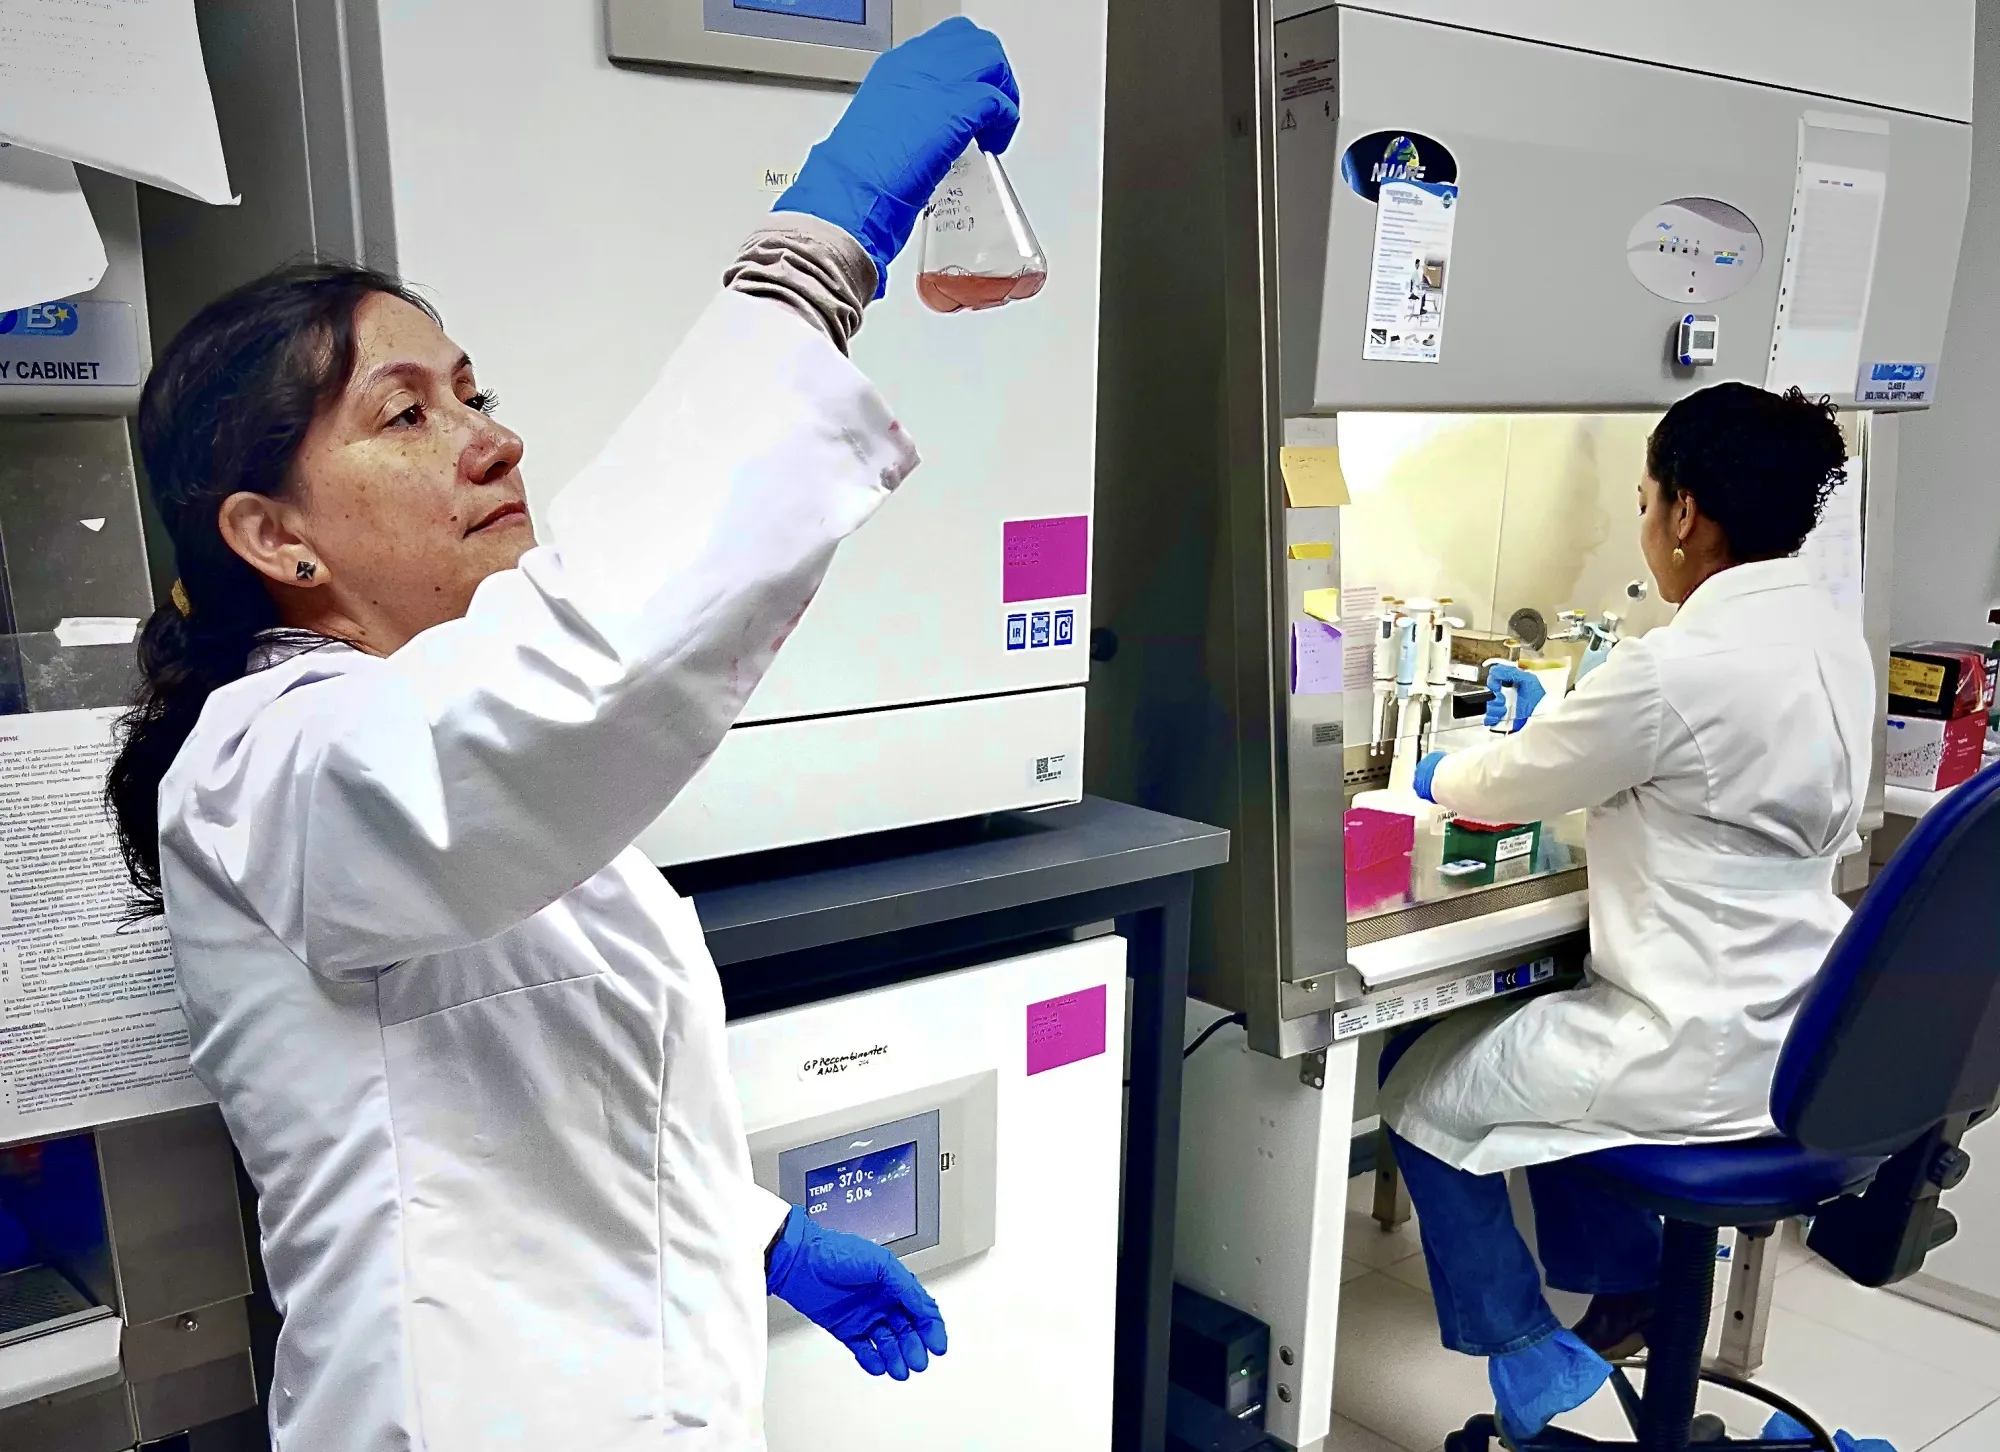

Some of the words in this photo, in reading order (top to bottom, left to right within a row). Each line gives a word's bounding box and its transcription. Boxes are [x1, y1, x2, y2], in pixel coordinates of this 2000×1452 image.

[16, 361, 100, 380] CABINET
[809, 1182, 835, 1197] TEMP
[809, 1202, 828, 1215] CO2
